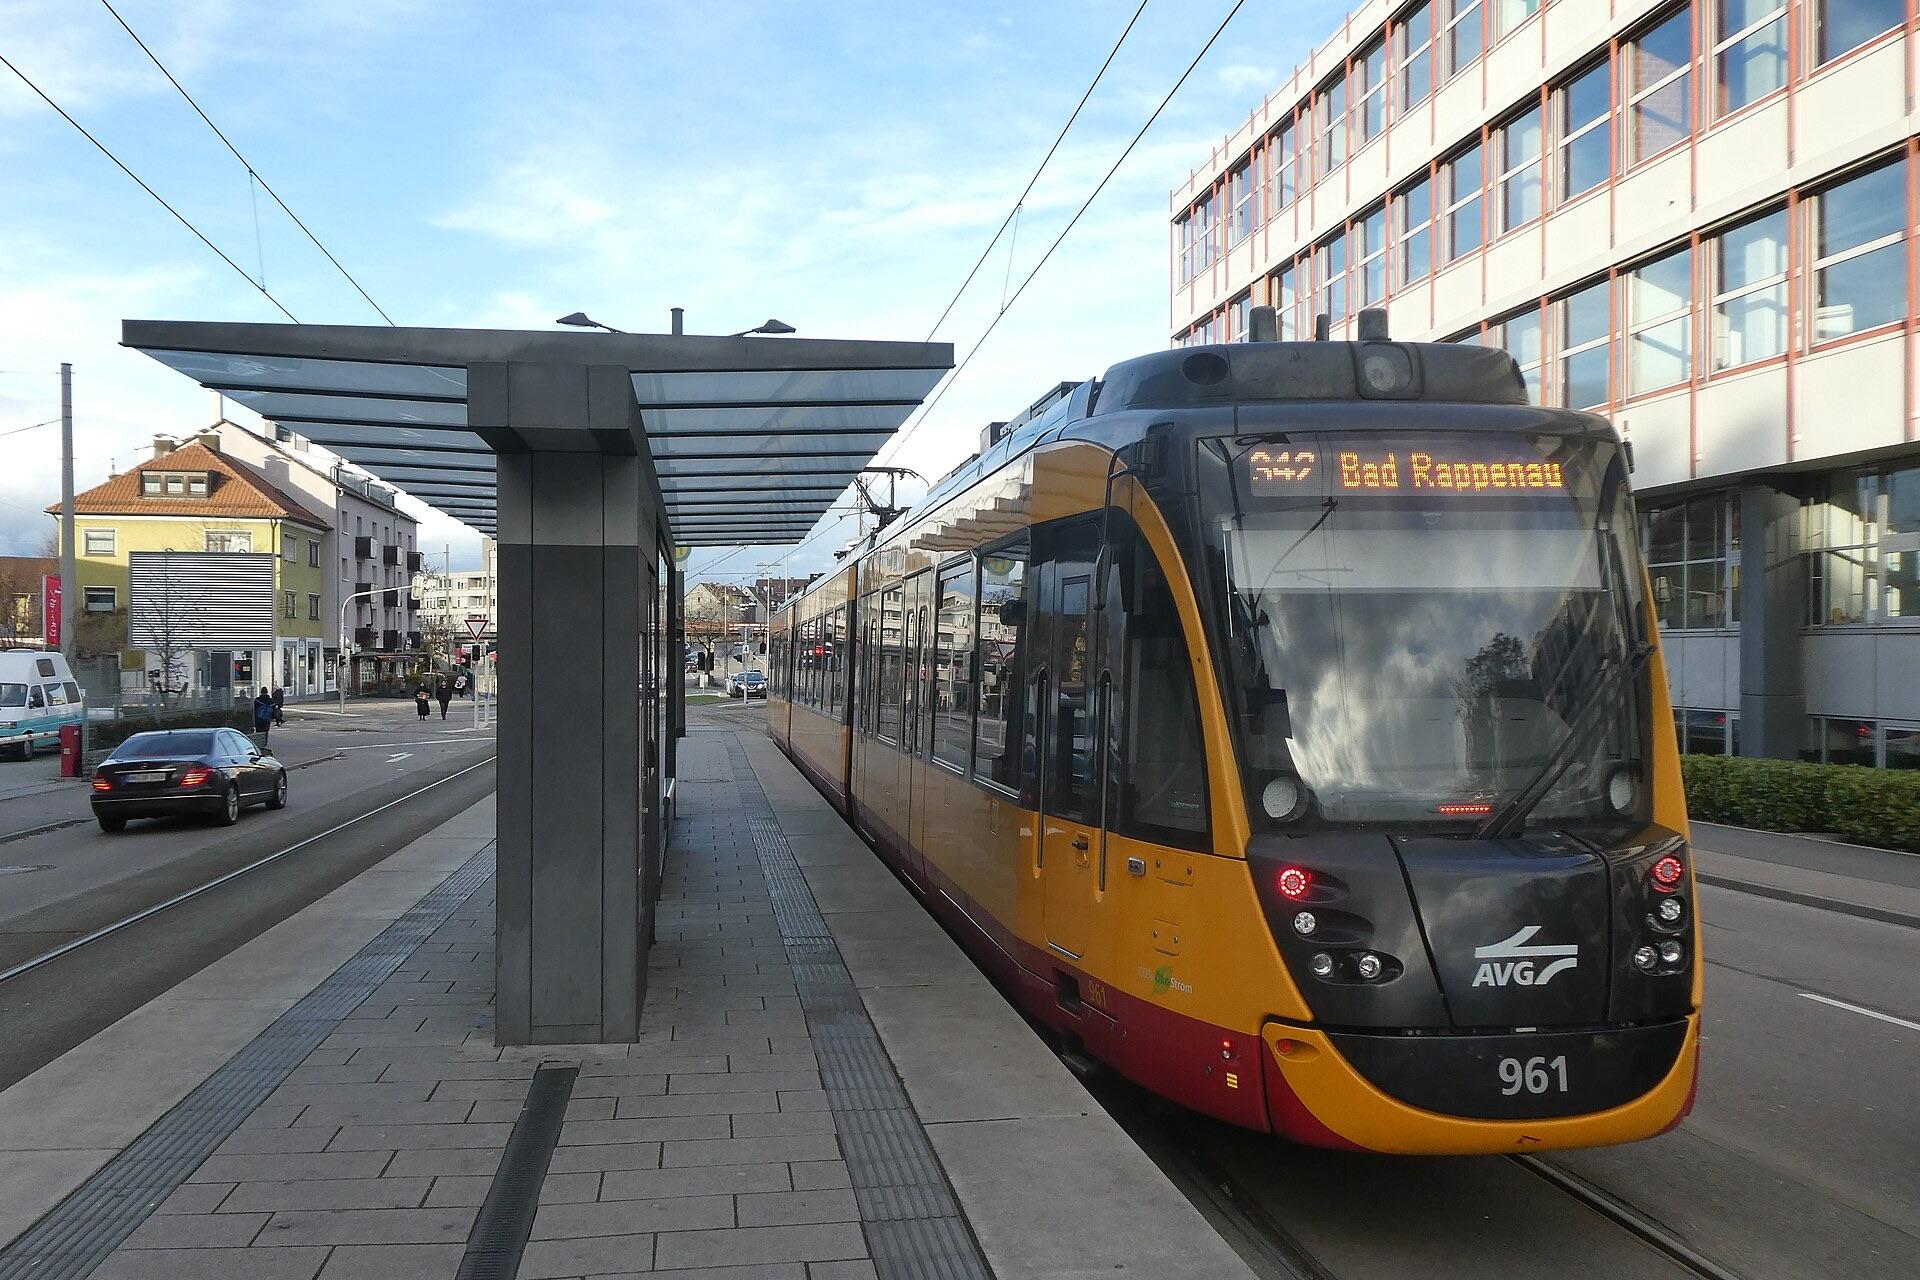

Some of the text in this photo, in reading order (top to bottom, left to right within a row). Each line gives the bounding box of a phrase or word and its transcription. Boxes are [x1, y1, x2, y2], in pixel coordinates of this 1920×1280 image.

[1341, 452, 1399, 487] Bad
[1411, 452, 1563, 491] Rappenau
[1472, 962, 1535, 987] AVG
[1088, 979, 1107, 1009] 961
[1499, 1055, 1568, 1096] 961
